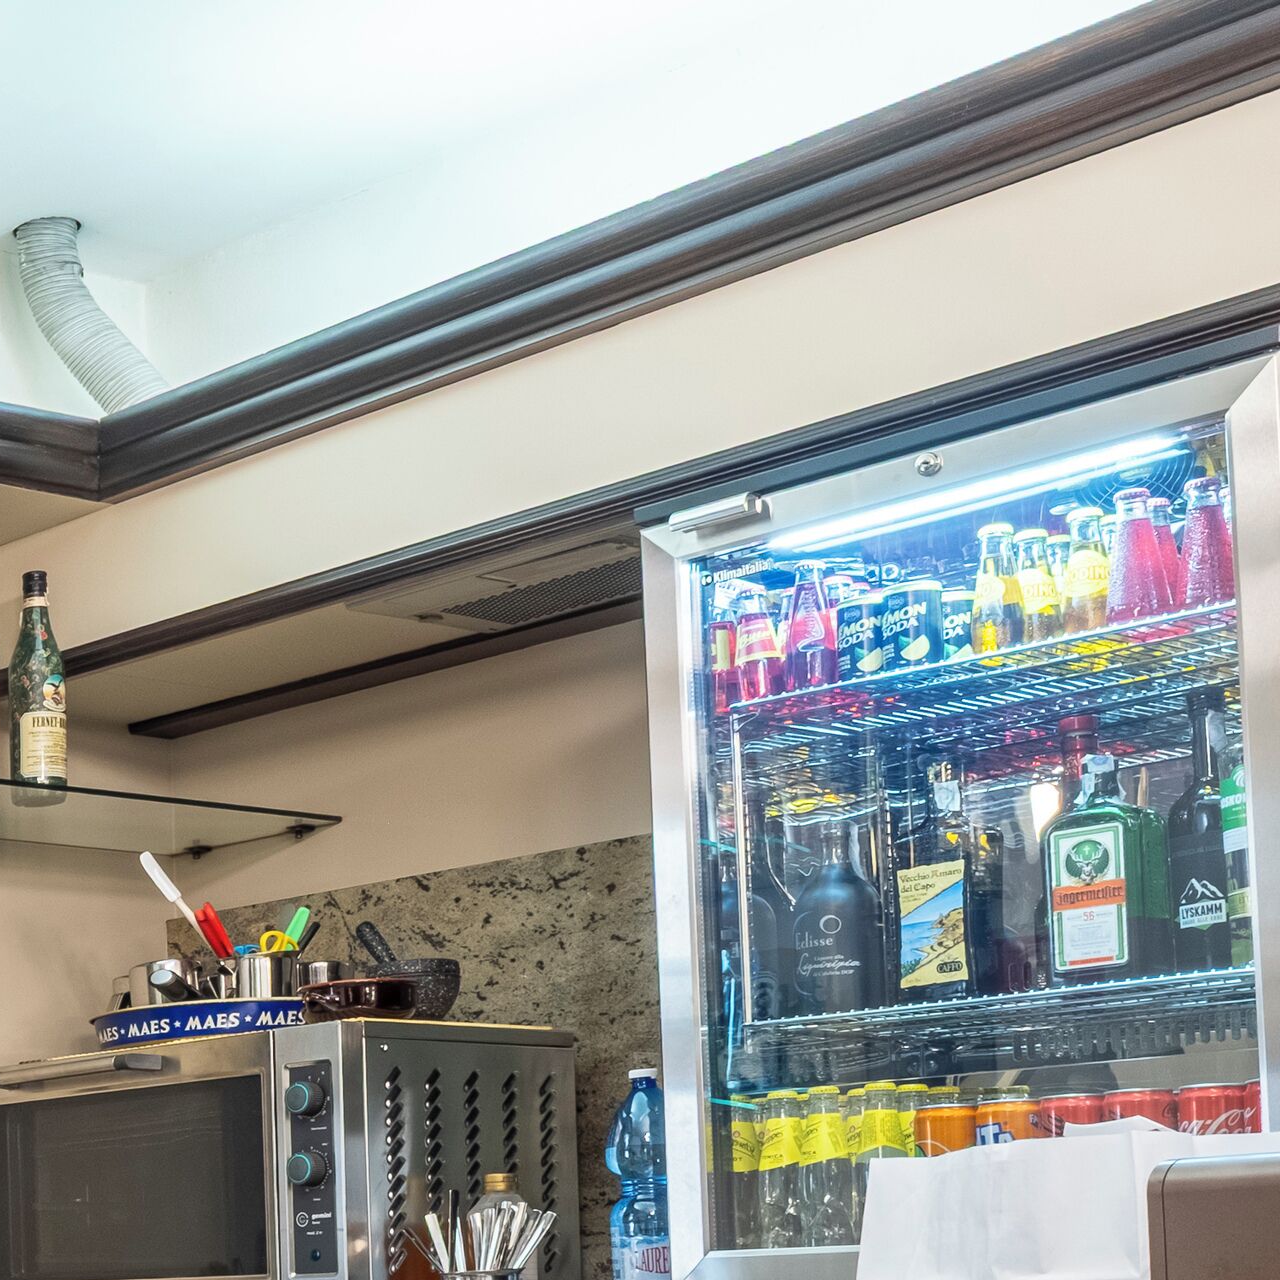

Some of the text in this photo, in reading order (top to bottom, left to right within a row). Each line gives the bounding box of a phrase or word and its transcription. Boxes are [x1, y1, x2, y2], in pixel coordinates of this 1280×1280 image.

[899, 867, 962, 883] Vecchio Amaro
[901, 882, 936, 894] del Capo
[1083, 911, 1095, 921] 56
[1181, 902, 1223, 918] LYSKAMM
[938, 961, 961, 972] CAFFO
[127, 1018, 171, 1039] MAES
[184, 1011, 241, 1032] MAES
[255, 1010, 305, 1027] MAES
